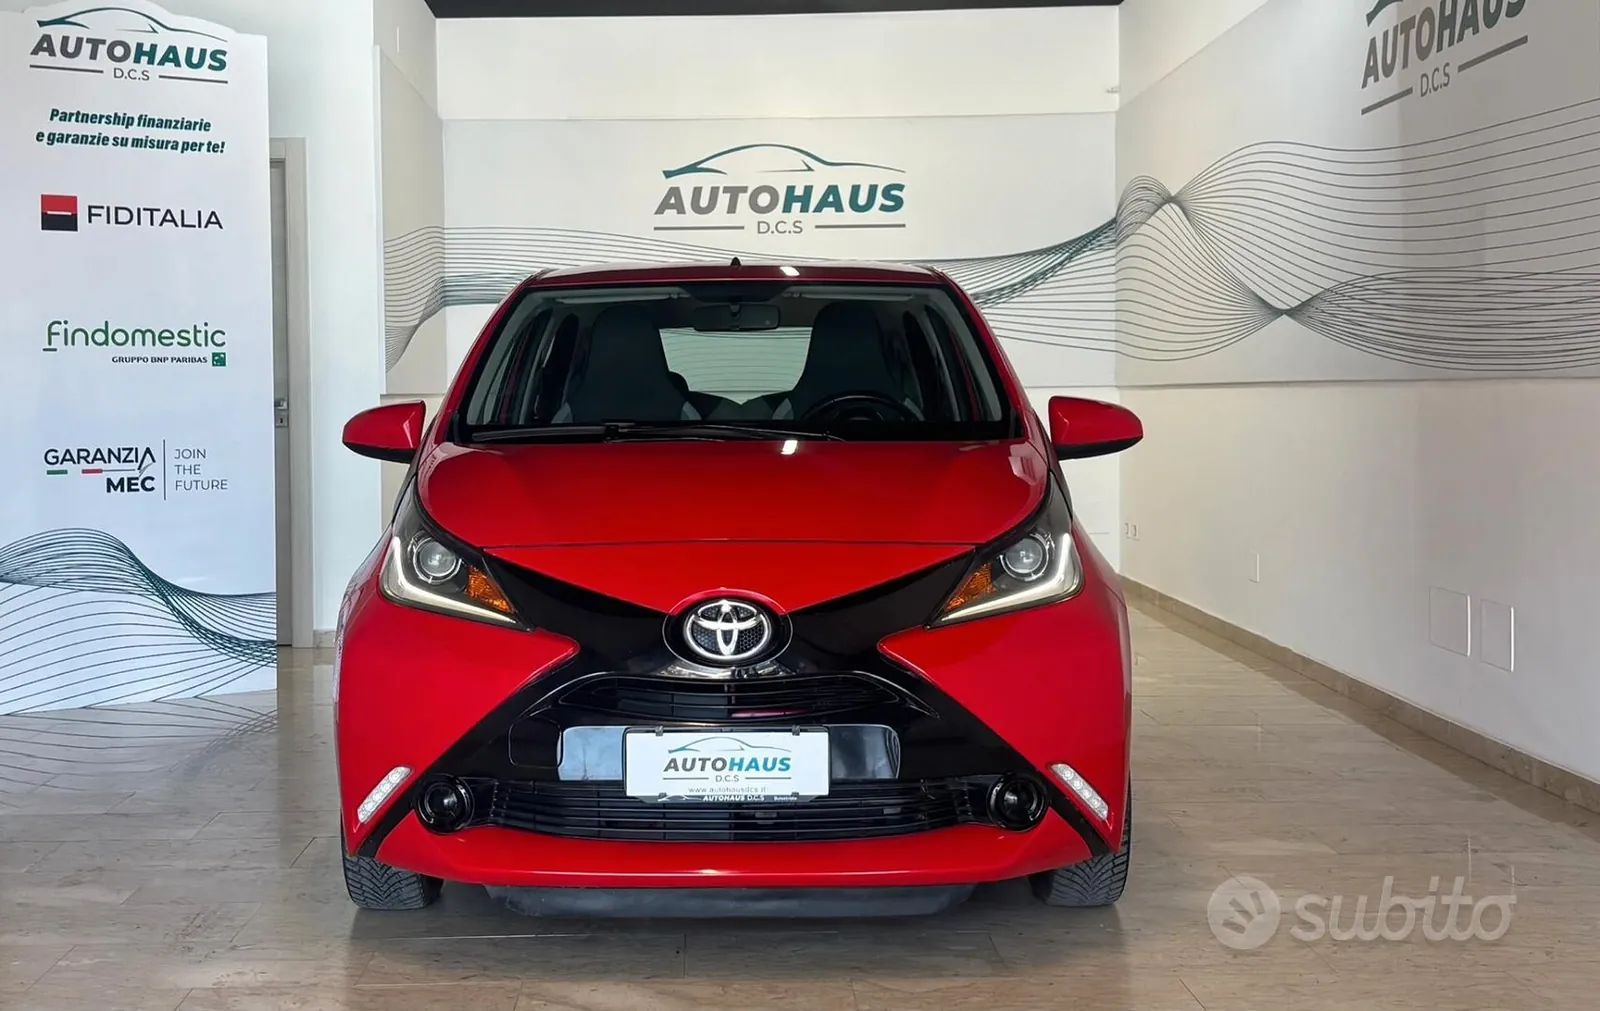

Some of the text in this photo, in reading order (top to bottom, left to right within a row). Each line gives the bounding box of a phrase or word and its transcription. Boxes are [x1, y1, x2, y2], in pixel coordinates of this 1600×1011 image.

[30, 34, 228, 71] AUTOHAUS
[1361, 0, 1526, 89] AUTOHAU
[113, 68, 150, 81] D.C.S
[1421, 62, 1450, 97] D.C.S
[50, 108, 211, 132] Partnership finanziarie
[36, 131, 225, 154] e garanzie su misura per te!
[654, 183, 905, 215] AUTOHAUS
[85, 205, 223, 229] FIDITALIA
[757, 220, 803, 234] D.C.S
[46, 320, 226, 348] findomestic
[44, 447, 156, 470] GARANZIA
[174, 449, 206, 459] JOIN
[175, 464, 201, 475] THE
[106, 476, 155, 493] MEC
[175, 479, 229, 491] FUTURE
[663, 757, 791, 772] AUTOHAUS
[715, 774, 740, 782] D.C.S
